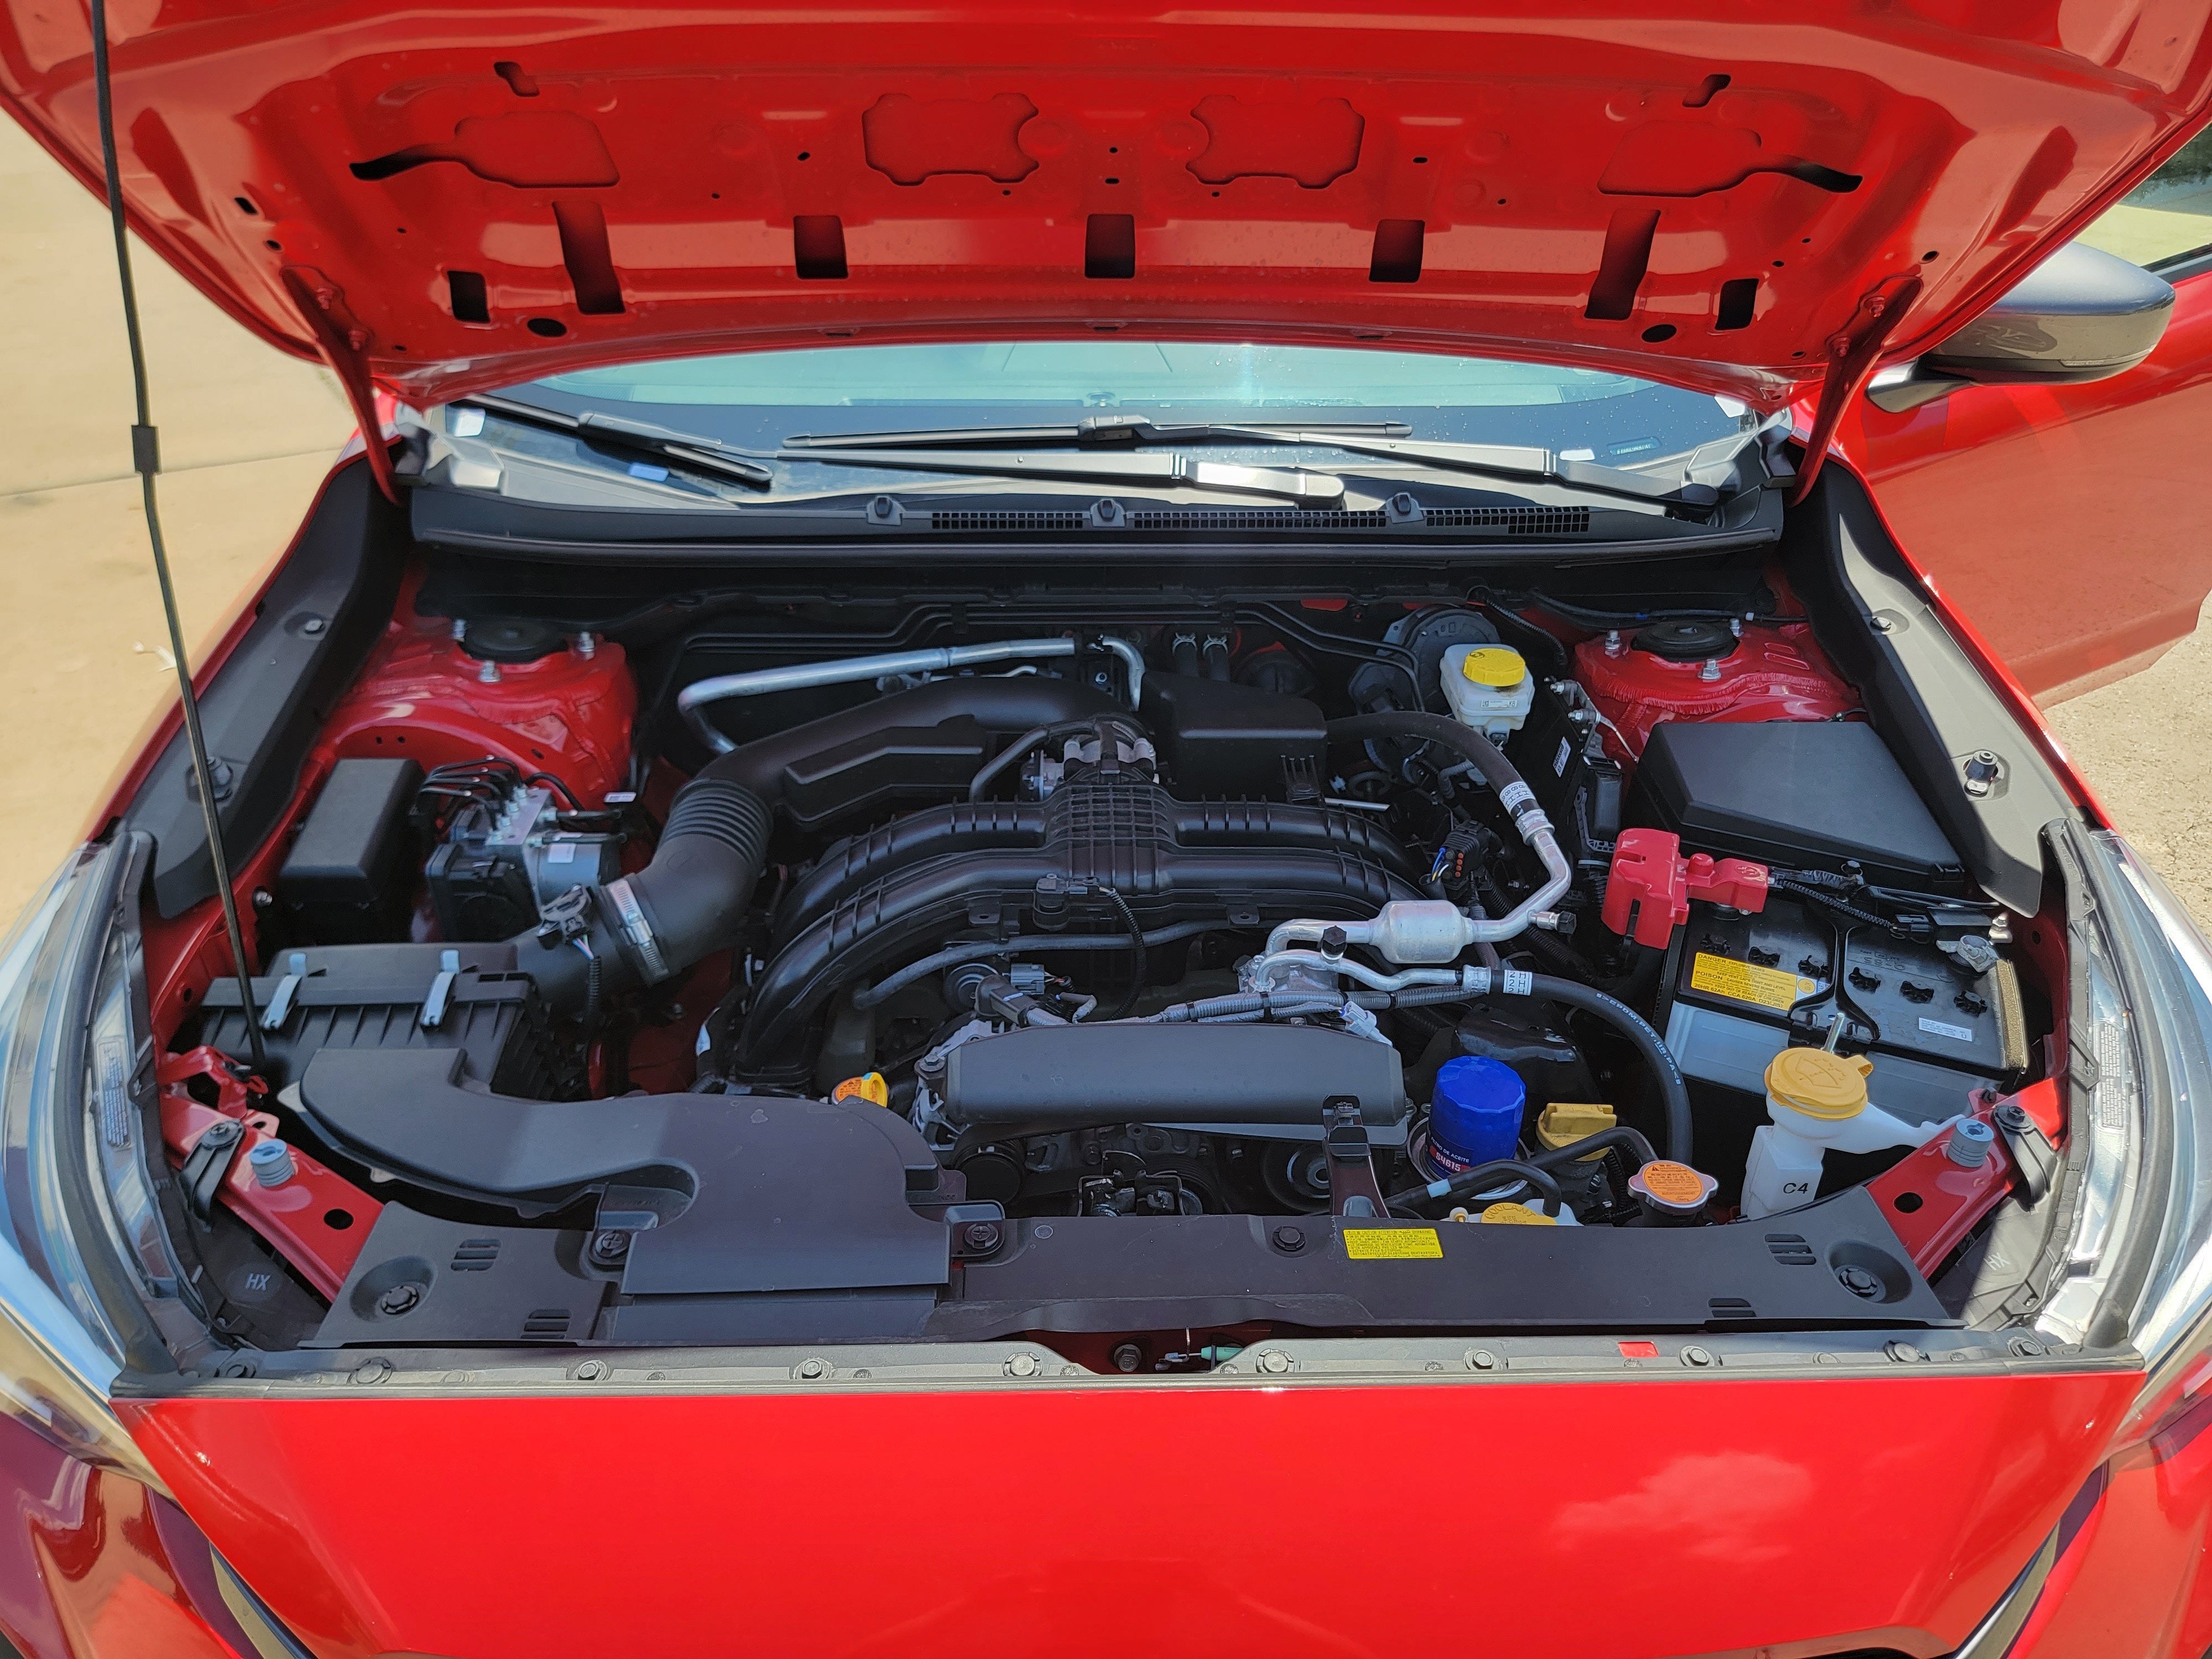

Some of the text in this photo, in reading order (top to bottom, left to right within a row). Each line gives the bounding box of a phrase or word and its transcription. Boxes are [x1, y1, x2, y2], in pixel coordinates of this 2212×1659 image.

[1698, 954, 1726, 964] DANGER
[1695, 971, 1723, 980] POISON
[1435, 1152, 1462, 1172] S4615
[1451, 1153, 1470, 1163] ACEITE
[1783, 1182, 1808, 1194] C4
[1484, 1203, 1536, 1219] COOLANT
[1983, 1251, 2011, 1271] HX
[245, 1273, 272, 1291] HX
